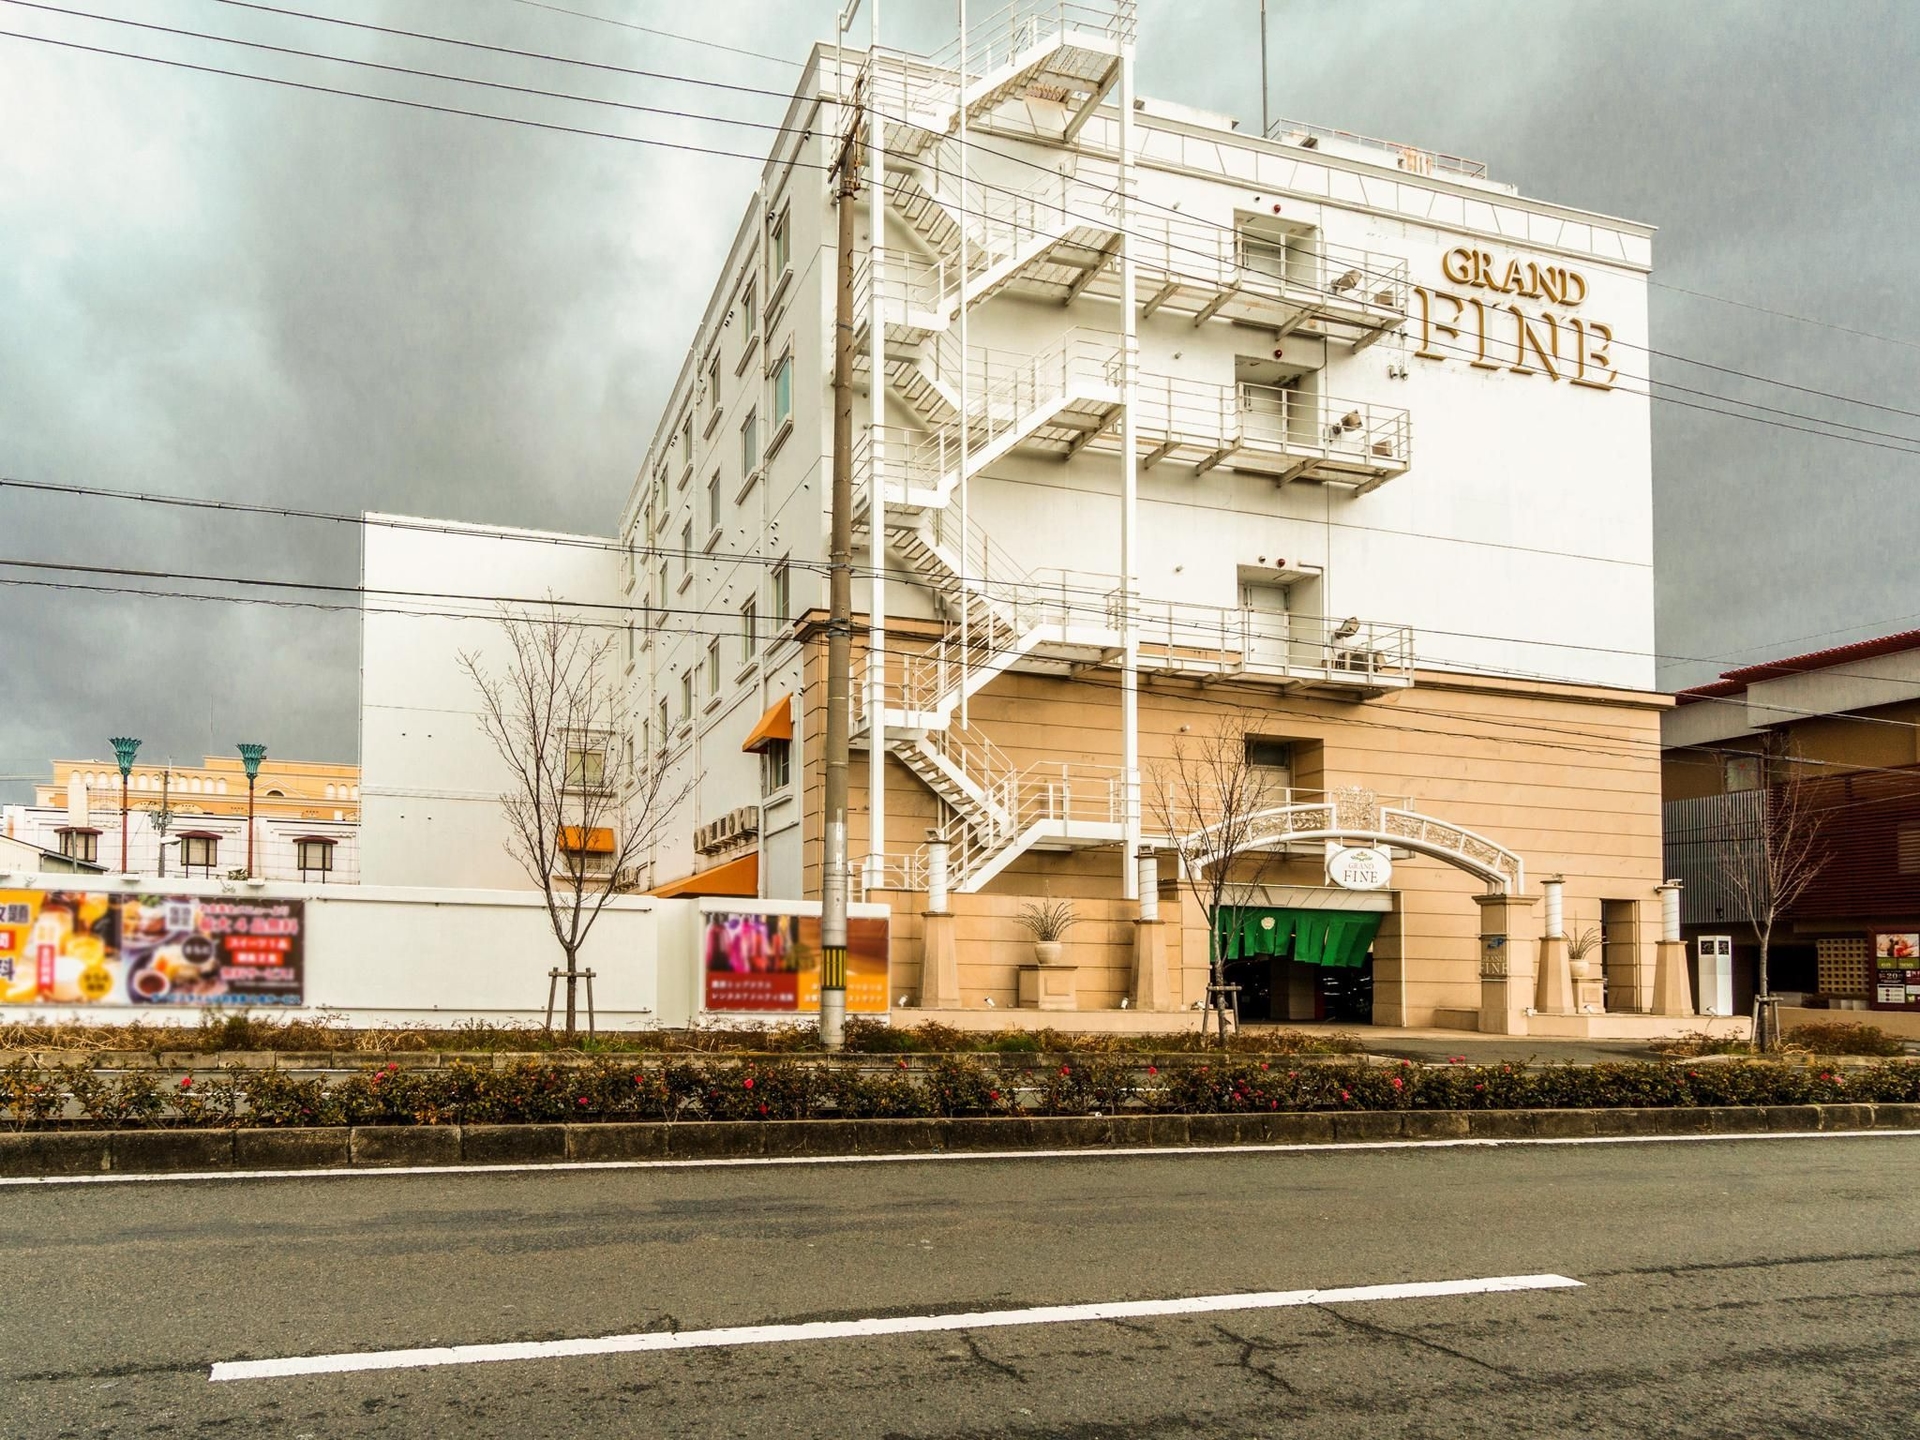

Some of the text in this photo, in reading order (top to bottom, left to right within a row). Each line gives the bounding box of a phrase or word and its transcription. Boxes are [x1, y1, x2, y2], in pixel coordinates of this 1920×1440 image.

[1442, 245, 1589, 306] GRAND
[1413, 286, 1618, 391] FINE
[1344, 870, 1378, 883] FINE
[1348, 862, 1374, 870] GRAND
